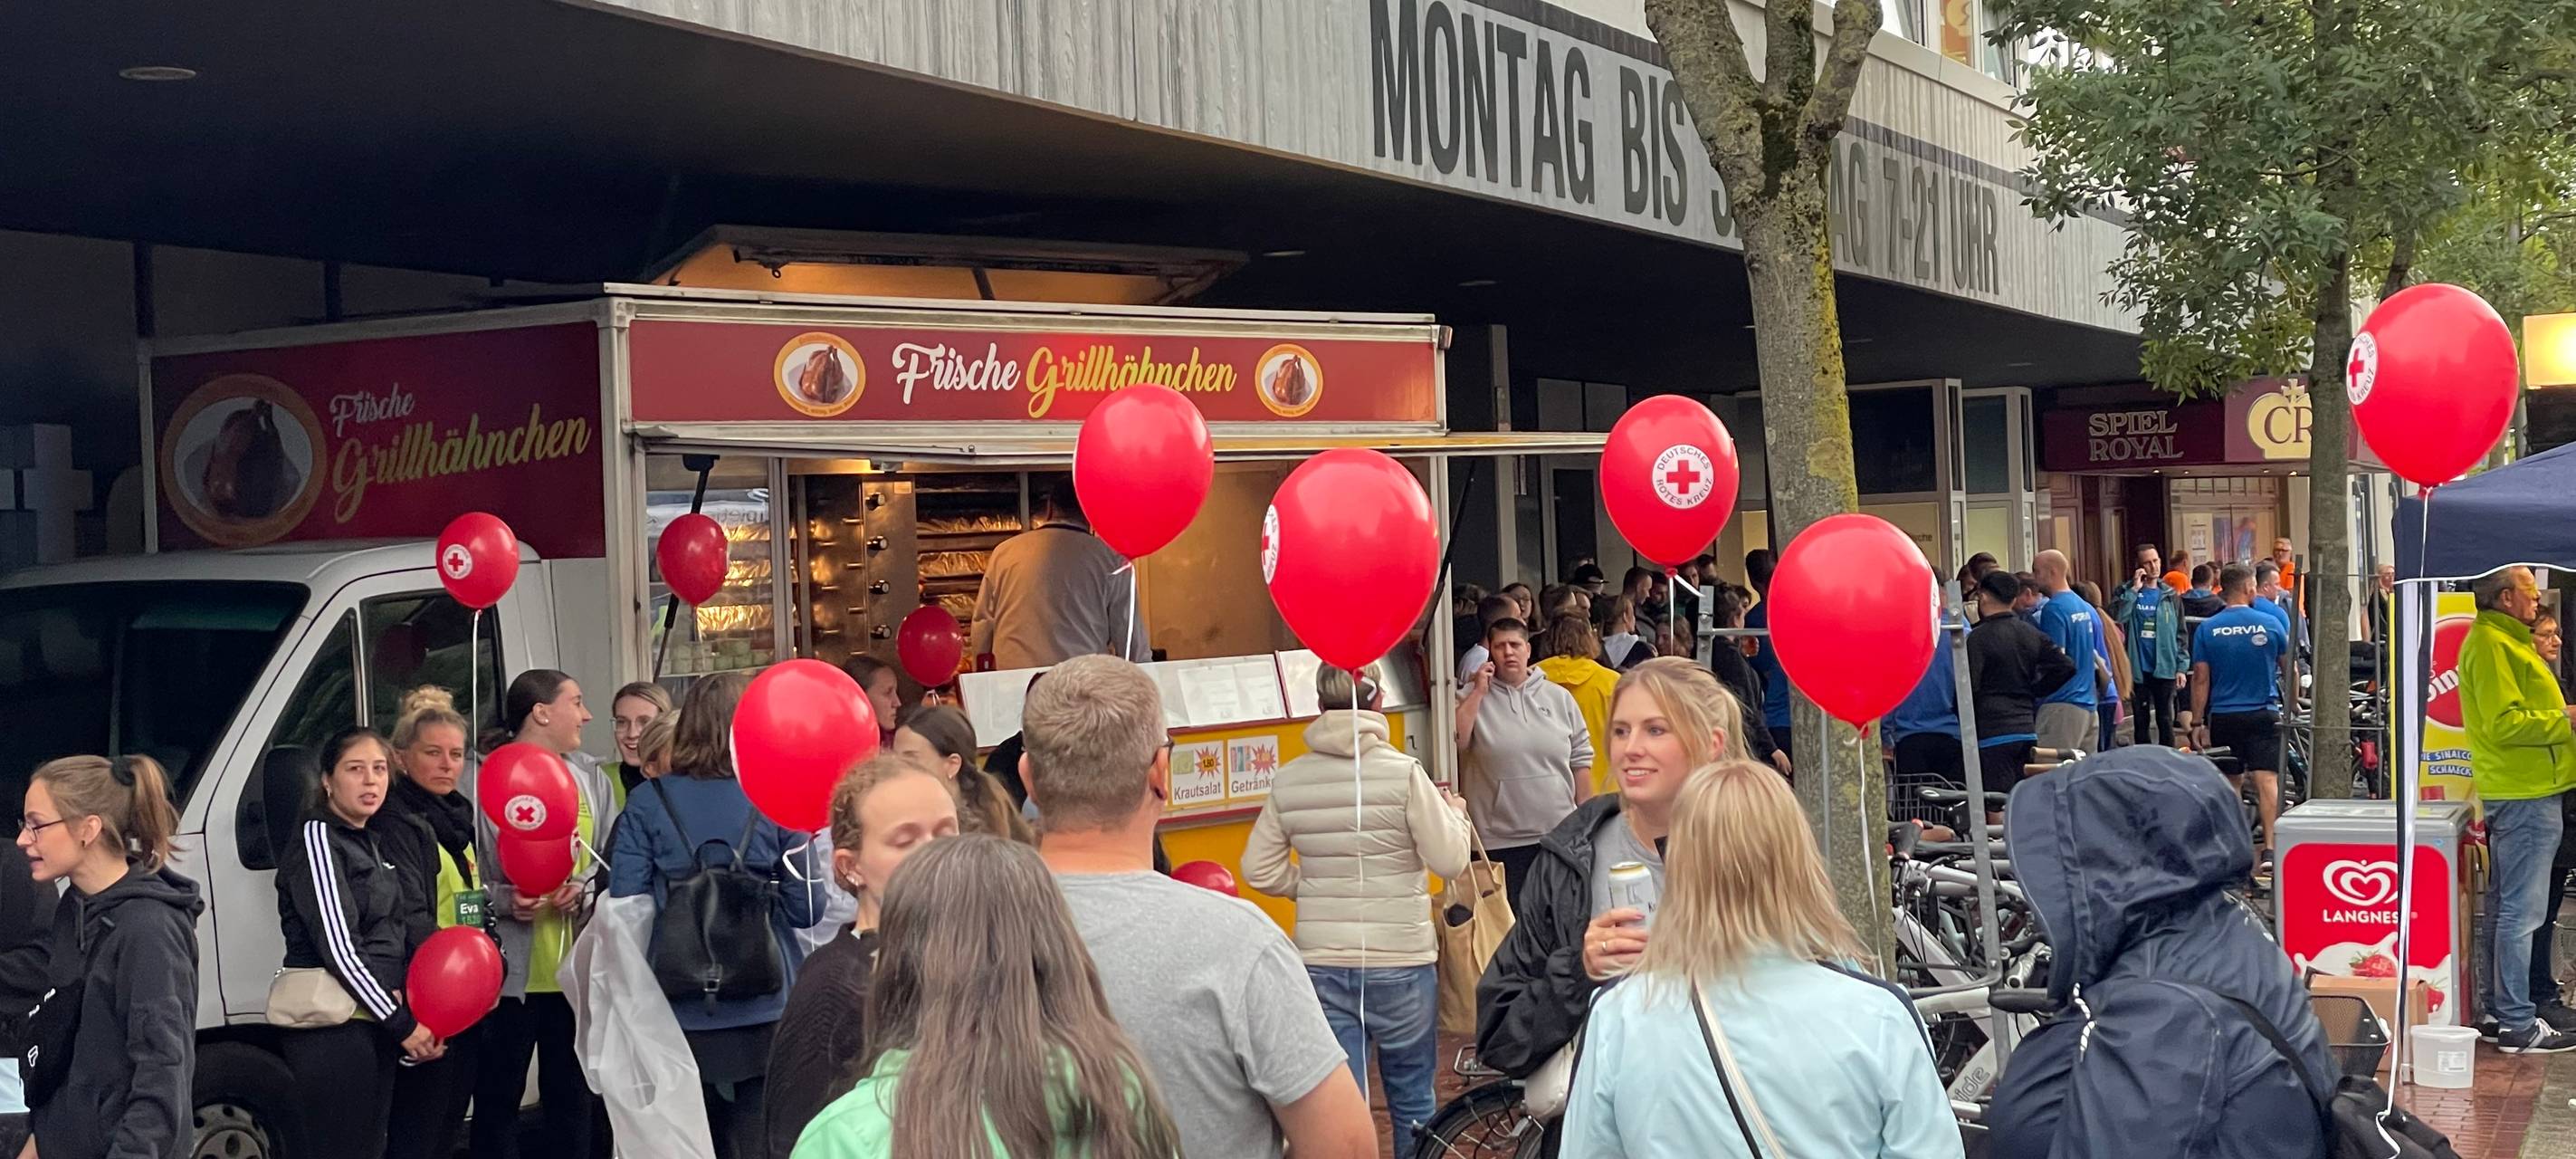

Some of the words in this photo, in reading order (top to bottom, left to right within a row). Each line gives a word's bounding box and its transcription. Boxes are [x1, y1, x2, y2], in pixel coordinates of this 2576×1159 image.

[1370, 0, 1595, 205] MONTAG
[1619, 65, 1687, 226] BIS
[1884, 157, 1942, 283] 7-21
[1950, 175, 2000, 295] UHR
[892, 342, 1021, 406] Frische
[1025, 344, 1237, 419] Grillhähnchen
[329, 382, 415, 438] Frische
[2088, 410, 2178, 436] SPIEL
[1656, 446, 1711, 471] DEUTSCHES
[2088, 435, 2185, 462] ROYAL
[332, 403, 592, 523] Grillhähnchen
[1655, 479, 1683, 505] ROTES
[1686, 477, 1713, 505] KREUZ
[2212, 624, 2266, 637] FORVIA
[2429, 764, 2473, 776] SCHMECK
[1174, 781, 1221, 800] Krautsalat
[460, 903, 479, 915] Eva
[2323, 908, 2399, 924] LANGNES
